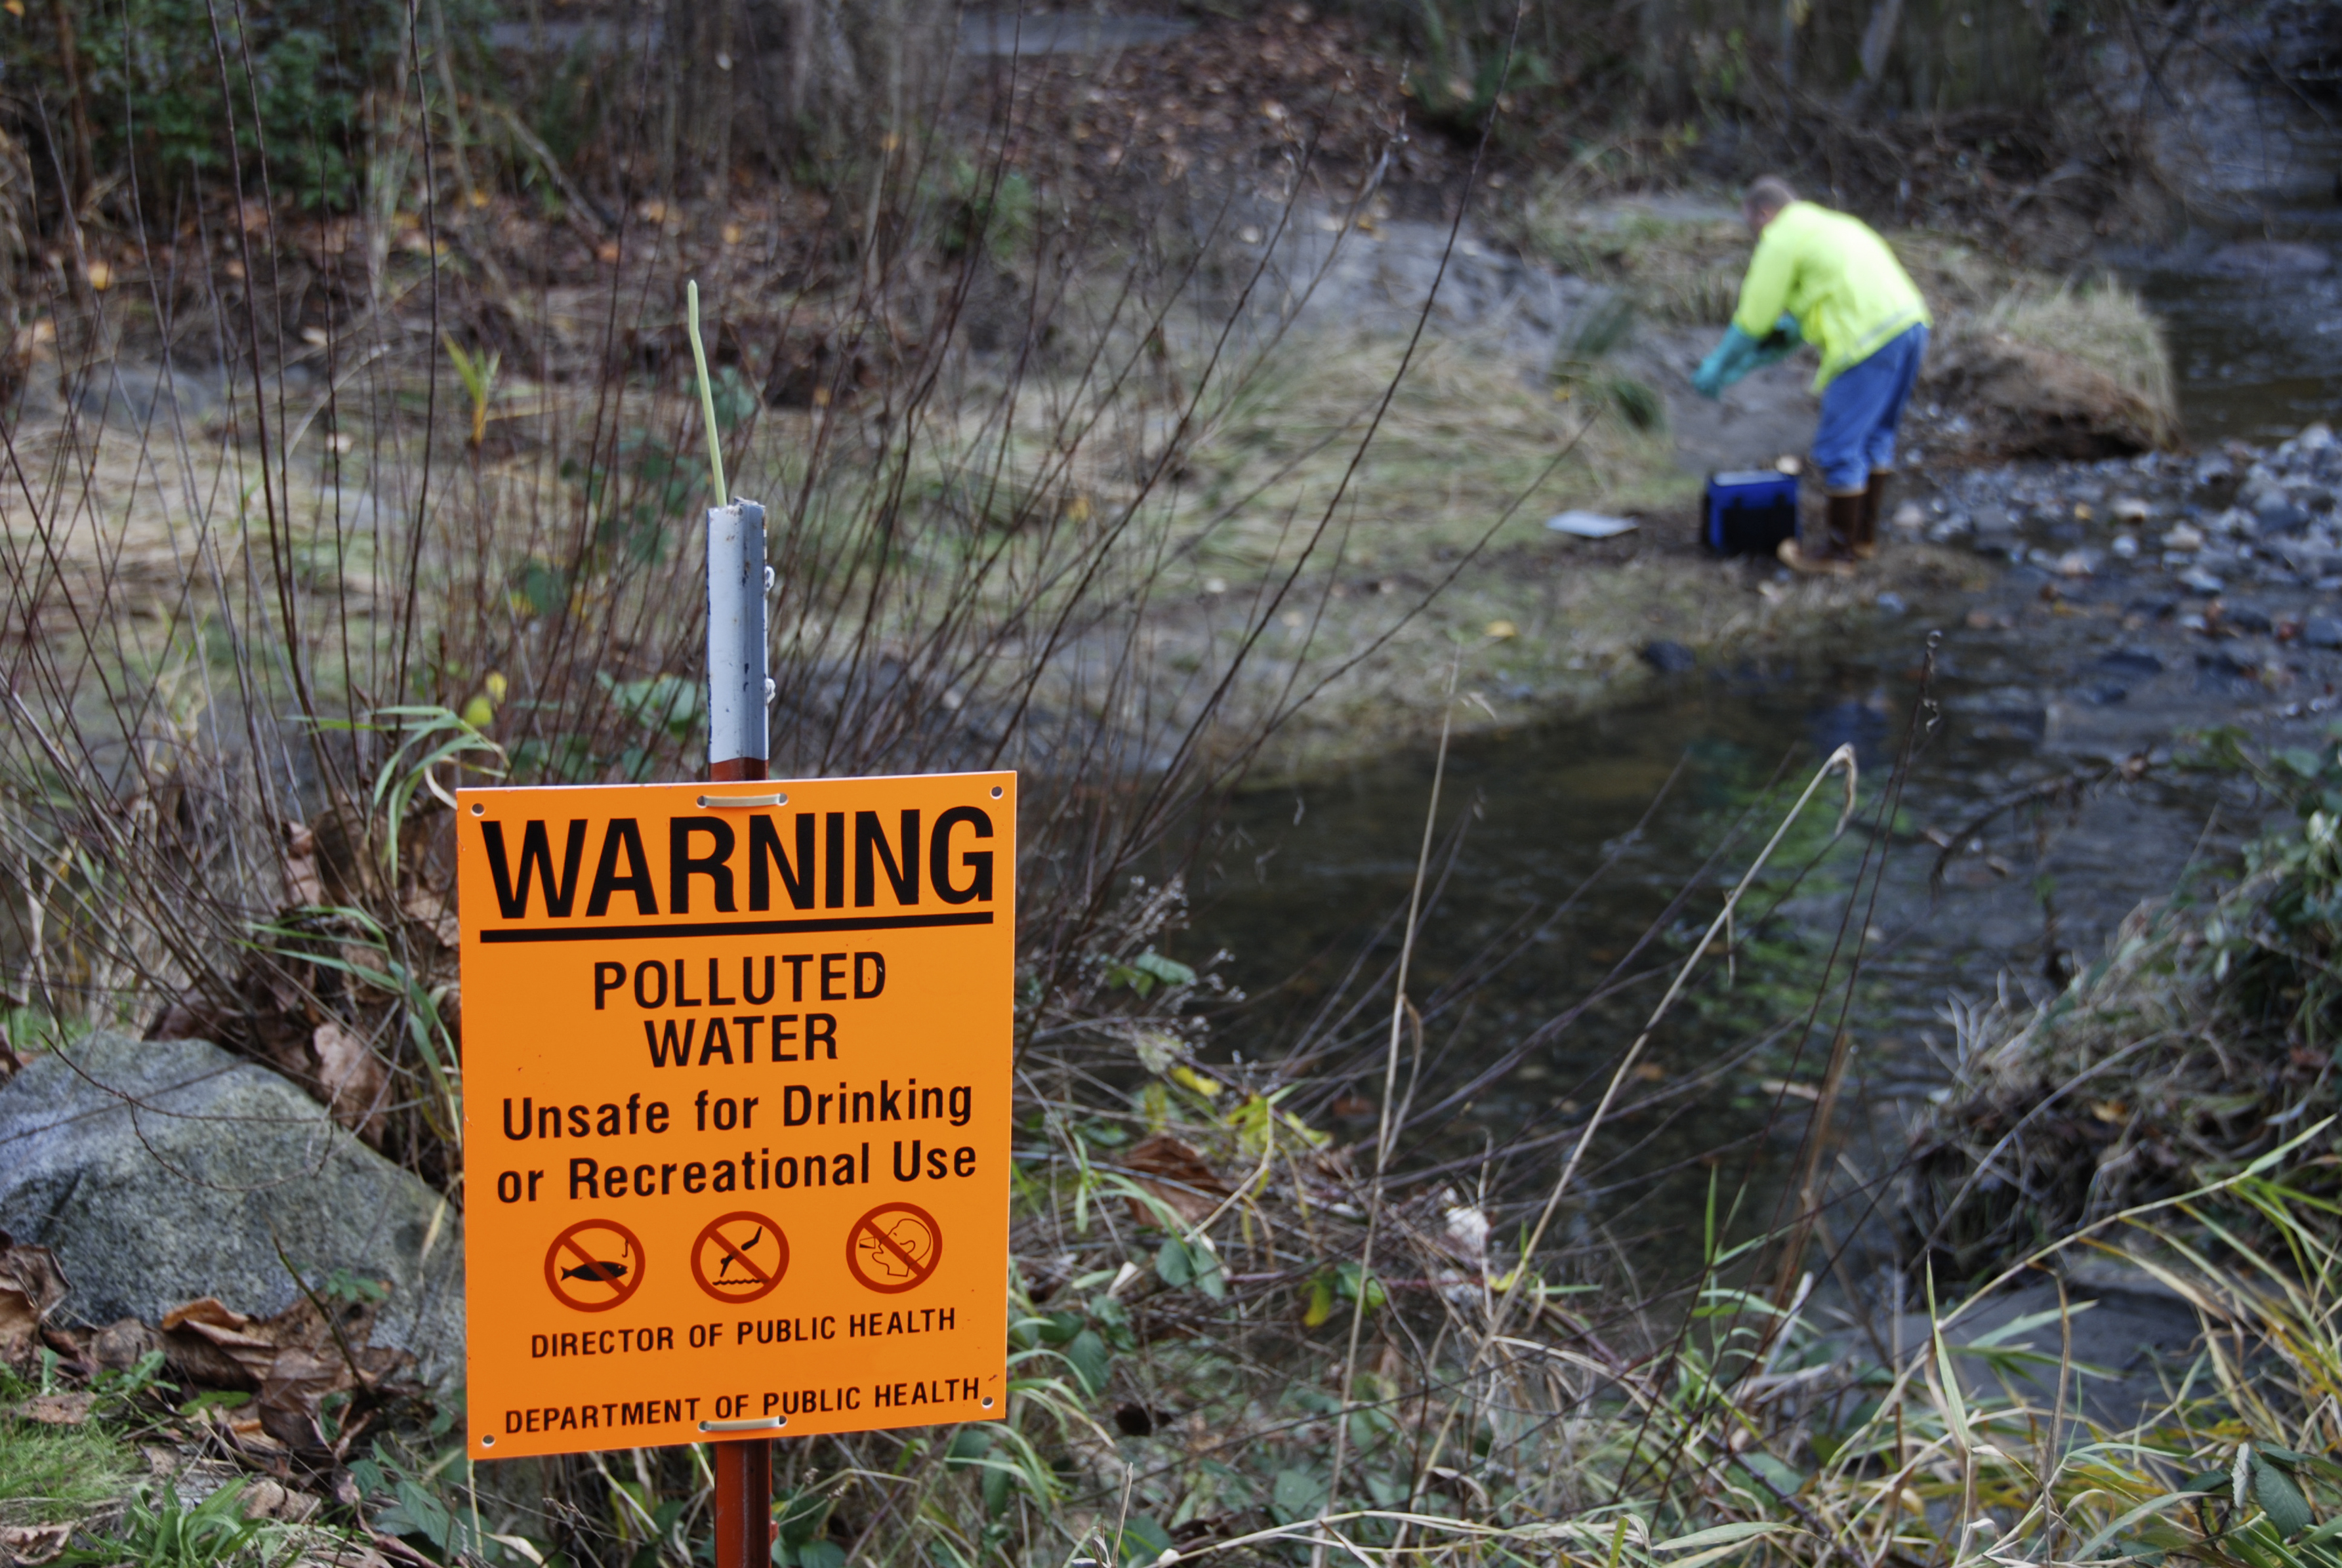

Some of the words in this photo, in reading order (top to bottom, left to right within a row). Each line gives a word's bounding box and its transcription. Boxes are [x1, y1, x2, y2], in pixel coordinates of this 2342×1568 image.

[481, 806, 993, 918] WARNING
[595, 952, 885, 1010] POLLUTED
[644, 1014, 836, 1067] WATER
[504, 1094, 668, 1140] Unsafe
[695, 1090, 758, 1130] for
[784, 1081, 970, 1126] Drinking
[498, 1171, 543, 1203] or
[570, 1143, 869, 1199] Recreational
[894, 1140, 975, 1182] Use
[533, 1327, 672, 1357] DIRECTOR
[689, 1324, 722, 1348] OF
[738, 1317, 834, 1344] PUBLIC
[850, 1308, 954, 1336] HEALTH
[506, 1397, 700, 1433] DEPARTMENT
[716, 1395, 748, 1418] OF
[764, 1388, 859, 1415] PUBLIC
[876, 1378, 978, 1407] HEALTH
